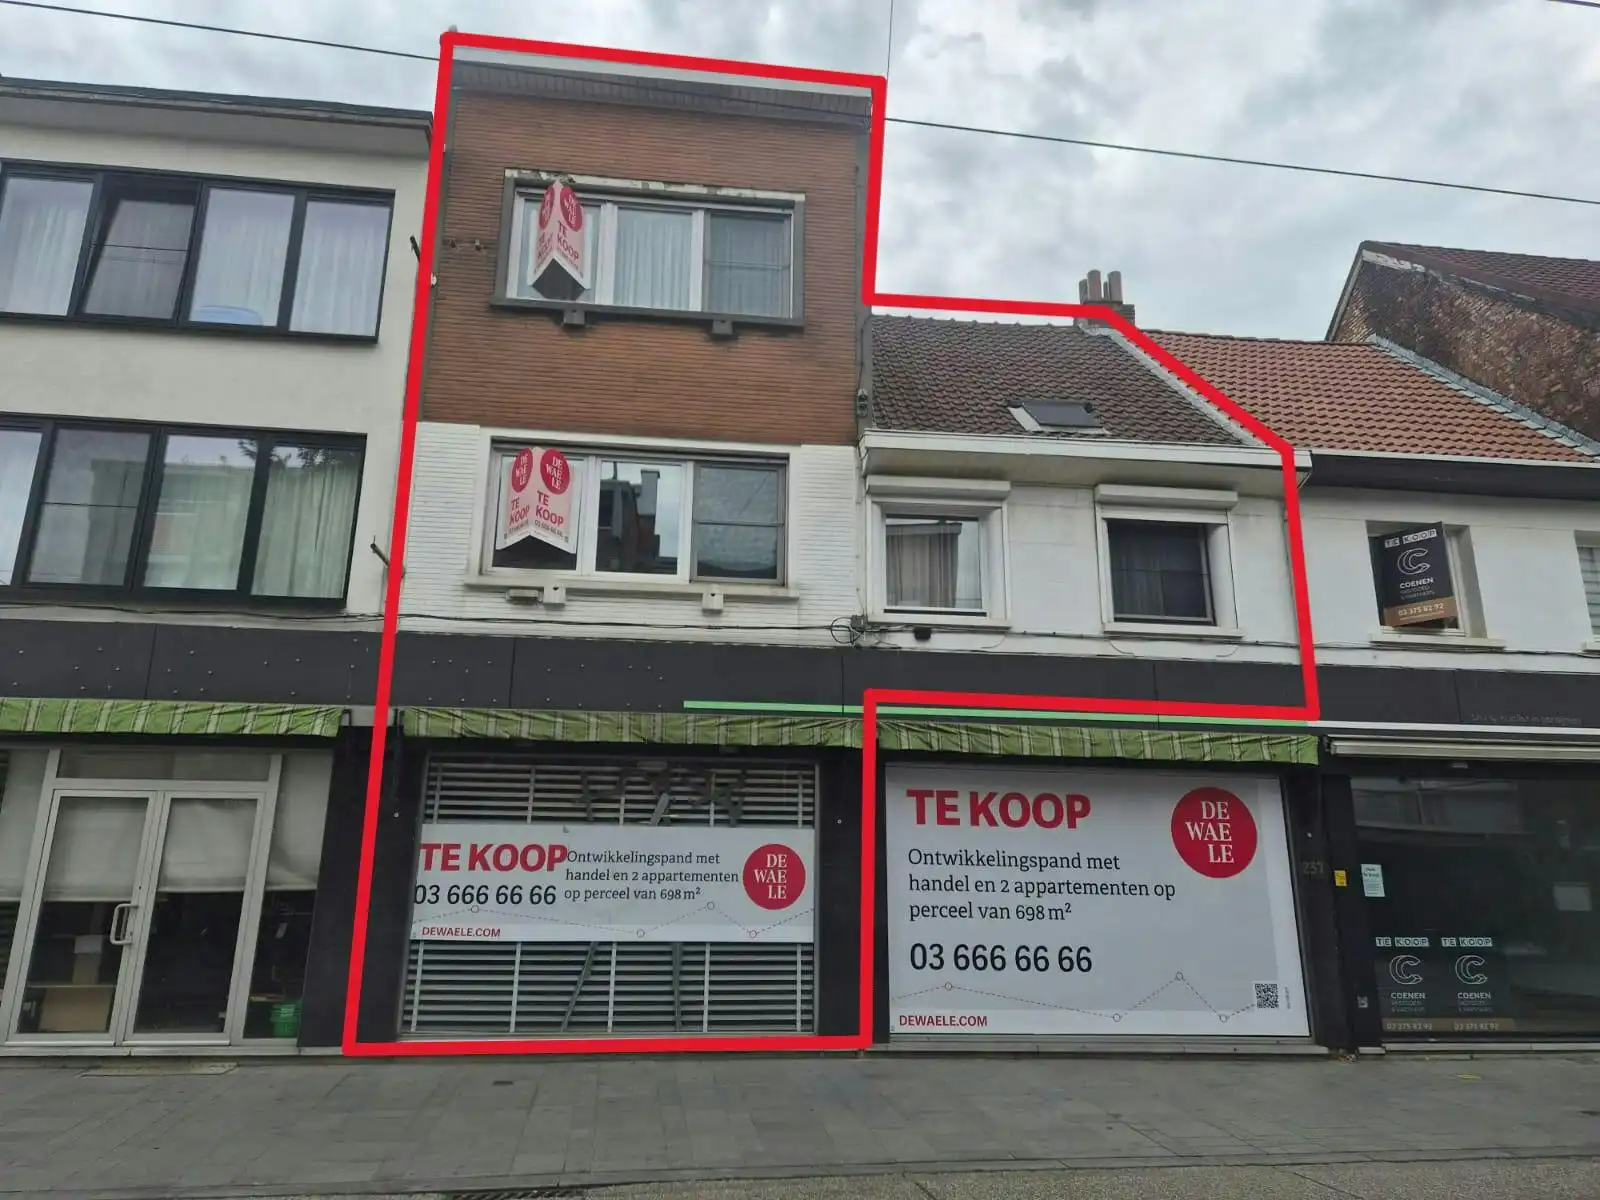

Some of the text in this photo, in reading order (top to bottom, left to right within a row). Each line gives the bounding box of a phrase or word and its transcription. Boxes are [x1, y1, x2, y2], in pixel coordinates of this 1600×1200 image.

[557, 233, 579, 260] KOOP
[552, 456, 563, 469] DE
[545, 463, 562, 480] WAE
[551, 479, 561, 490] LE
[537, 490, 550, 507] TE
[535, 504, 564, 526] KOOP
[1403, 529, 1437, 544] KOOP
[1400, 577, 1434, 589] COENEN
[906, 789, 1092, 828] TE KOOP
[1202, 801, 1229, 819] DE
[1185, 822, 1232, 841] WAE
[418, 842, 569, 873] TE KOOP
[566, 850, 720, 866] Ontwikkelingspand met
[767, 854, 787, 867] DE
[909, 849, 1120, 872] Ontwikkelingspand met
[1208, 844, 1234, 863] LE
[566, 869, 738, 884] handel en 2 appartementen
[755, 869, 786, 883] WAE
[414, 883, 556, 904] 03 666 66 66
[565, 890, 580, 902] op
[584, 887, 629, 902] perceel
[634, 891, 656, 899] van
[769, 885, 786, 899] LE
[909, 874, 1175, 900] handel en 2 appartementen op
[910, 902, 973, 921] perceel
[978, 907, 1010, 919] van
[1016, 905, 1044, 921] 698
[422, 927, 500, 937] DEWAELE.COM
[1376, 937, 1429, 947] TE KOOP
[1441, 937, 1493, 947] TE KOOP
[911, 943, 1092, 972] 03 666 66 66
[900, 1015, 987, 1026] DEWAELE.COM
